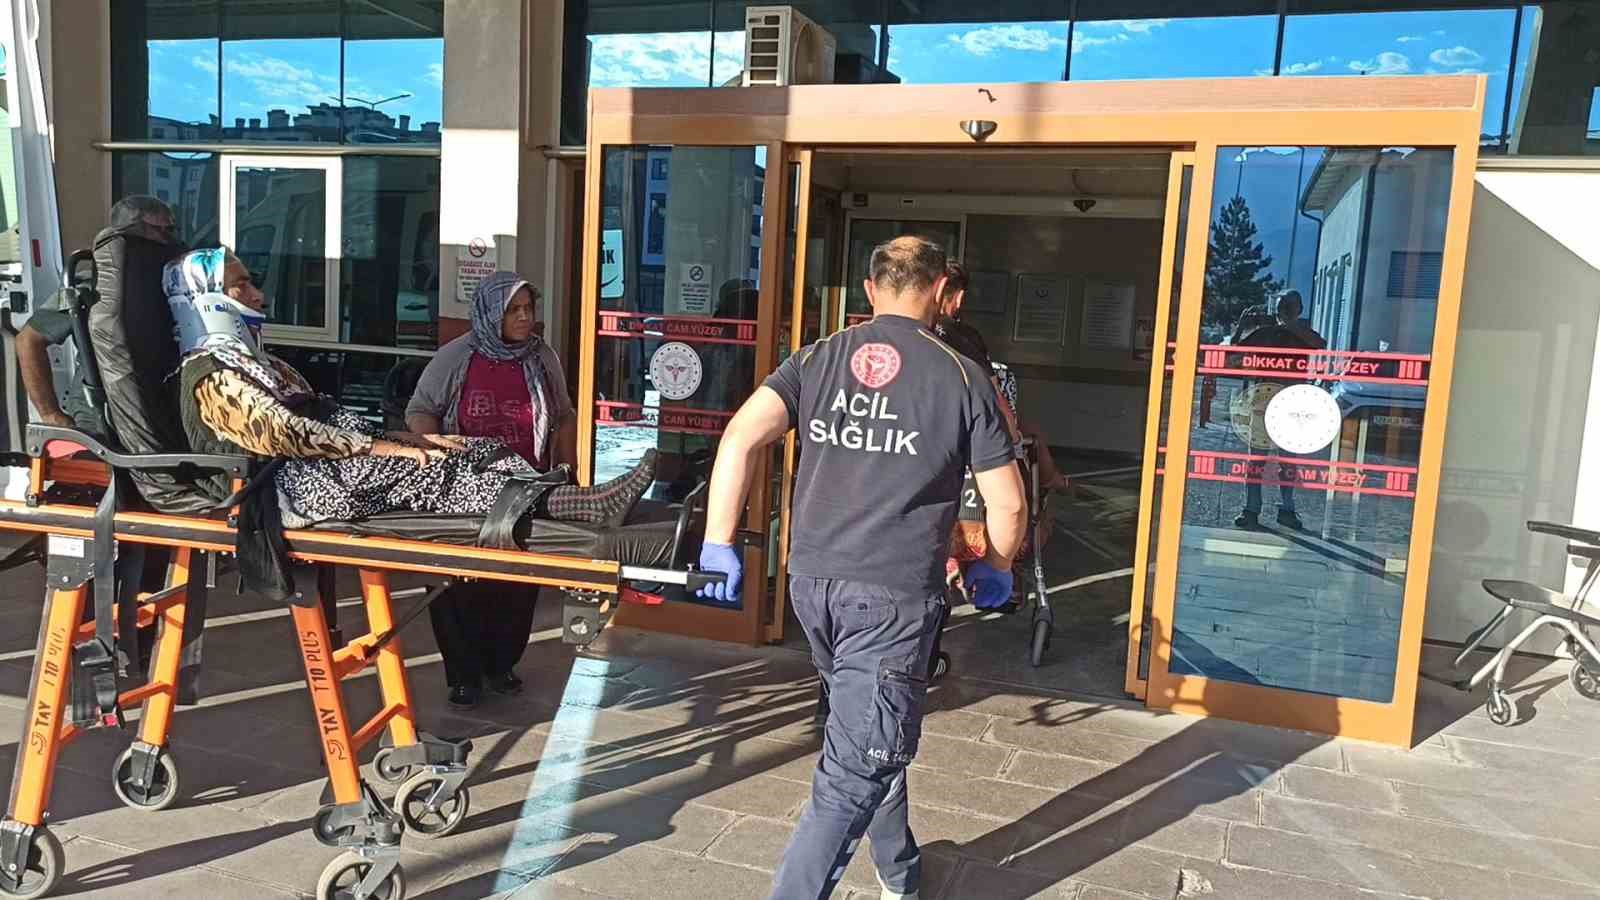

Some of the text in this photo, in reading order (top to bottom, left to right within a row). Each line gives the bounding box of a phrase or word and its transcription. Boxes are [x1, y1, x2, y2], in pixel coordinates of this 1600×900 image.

[1242, 355, 1293, 369] DİKKAT
[831, 388, 898, 420] ACİL
[809, 419, 920, 455] SAĞLIK
[35, 701, 51, 728] TAY
[320, 708, 339, 735] TAY
